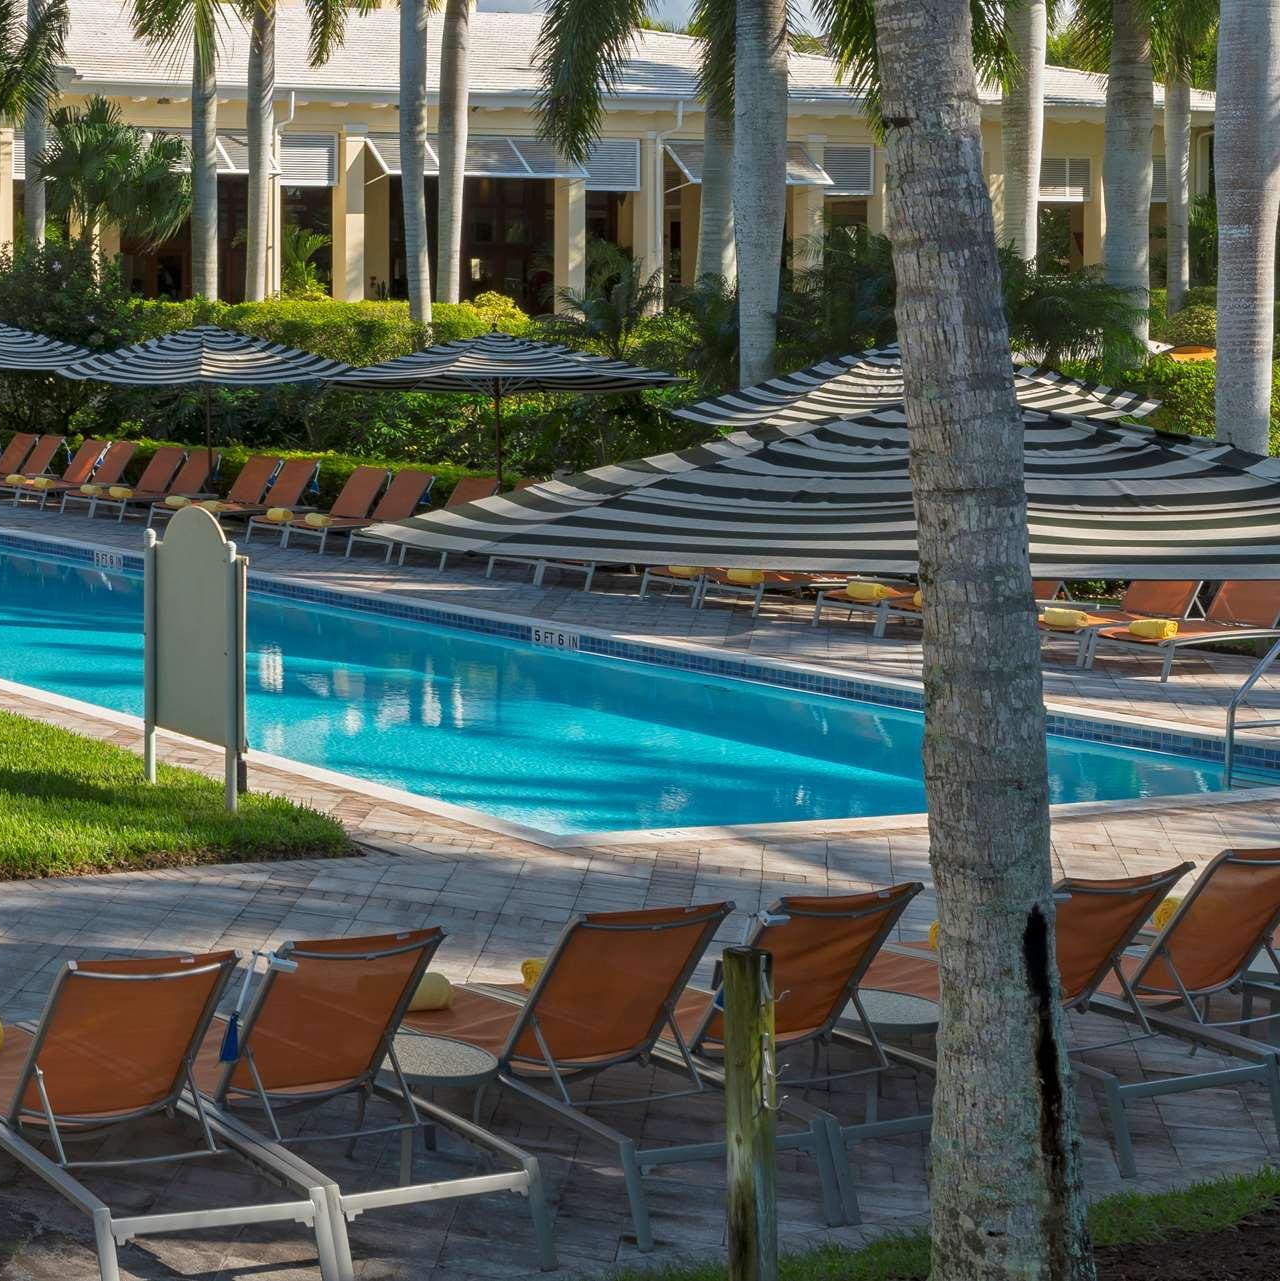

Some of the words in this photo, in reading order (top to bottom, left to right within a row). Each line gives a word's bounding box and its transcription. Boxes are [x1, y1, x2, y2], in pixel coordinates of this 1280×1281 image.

[534, 630, 541, 642] 5
[544, 631, 555, 645] FT
[558, 633, 565, 646] 6
[568, 634, 578, 649] IN
